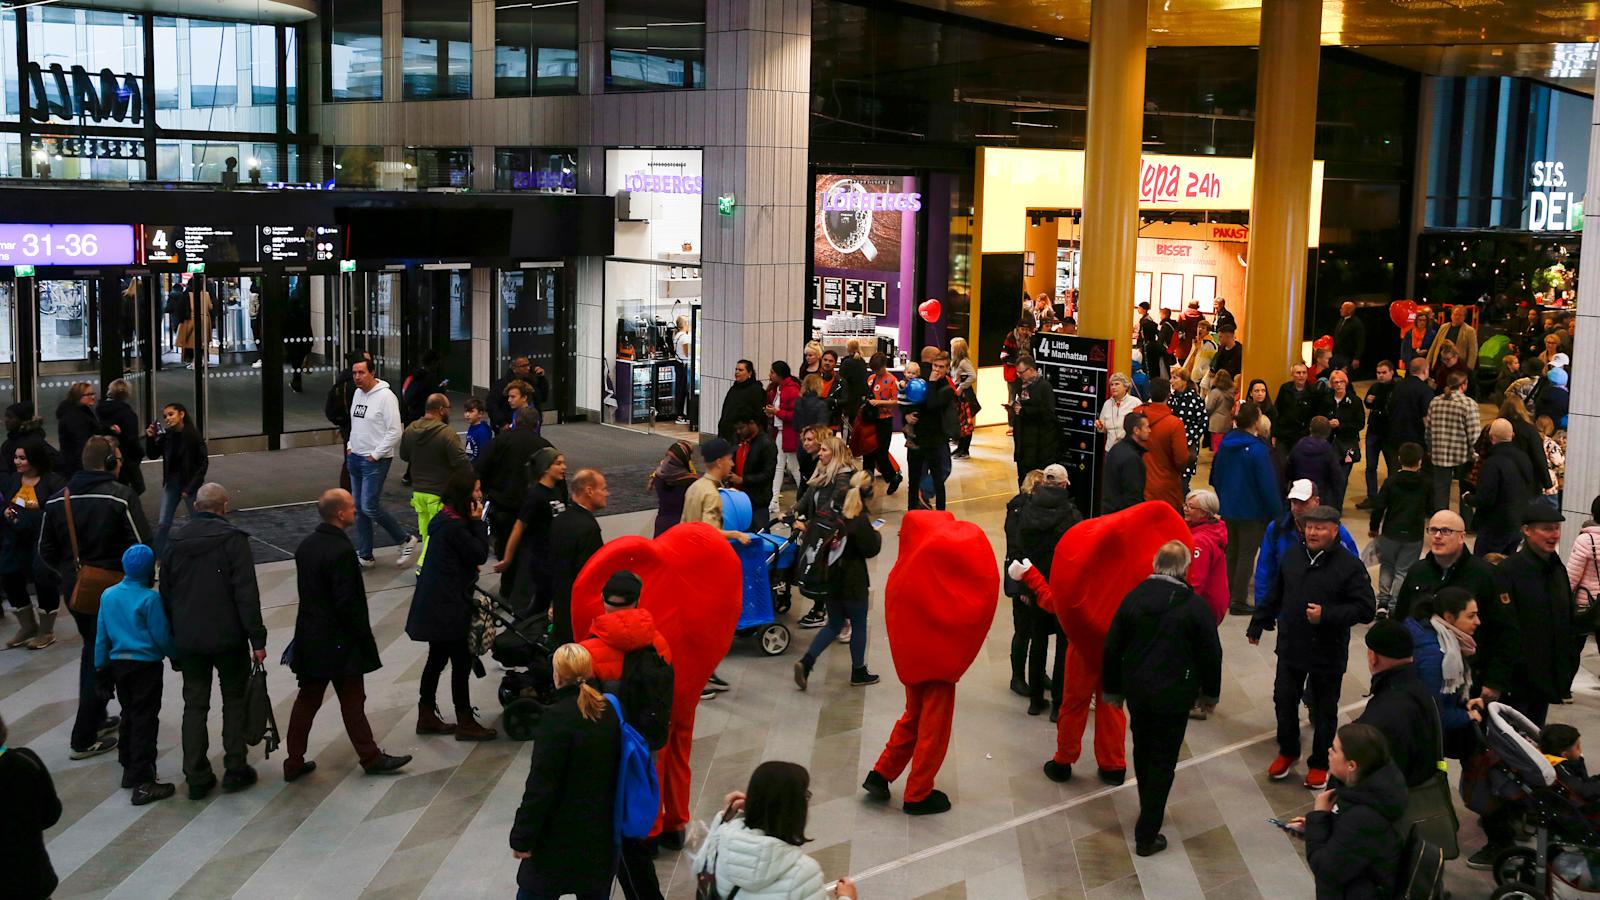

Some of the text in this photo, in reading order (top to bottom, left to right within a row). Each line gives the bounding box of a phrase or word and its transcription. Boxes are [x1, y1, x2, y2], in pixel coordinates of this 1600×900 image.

[1532, 160, 1567, 187] SIS.
[1185, 172, 1220, 198] 24h
[22, 233, 98, 257] 31-36
[152, 229, 169, 250] 4
[1156, 243, 1192, 257] BISSET
[1038, 337, 1051, 357] 4
[1051, 340, 1070, 351] Little
[1051, 349, 1088, 362] Manhattan
